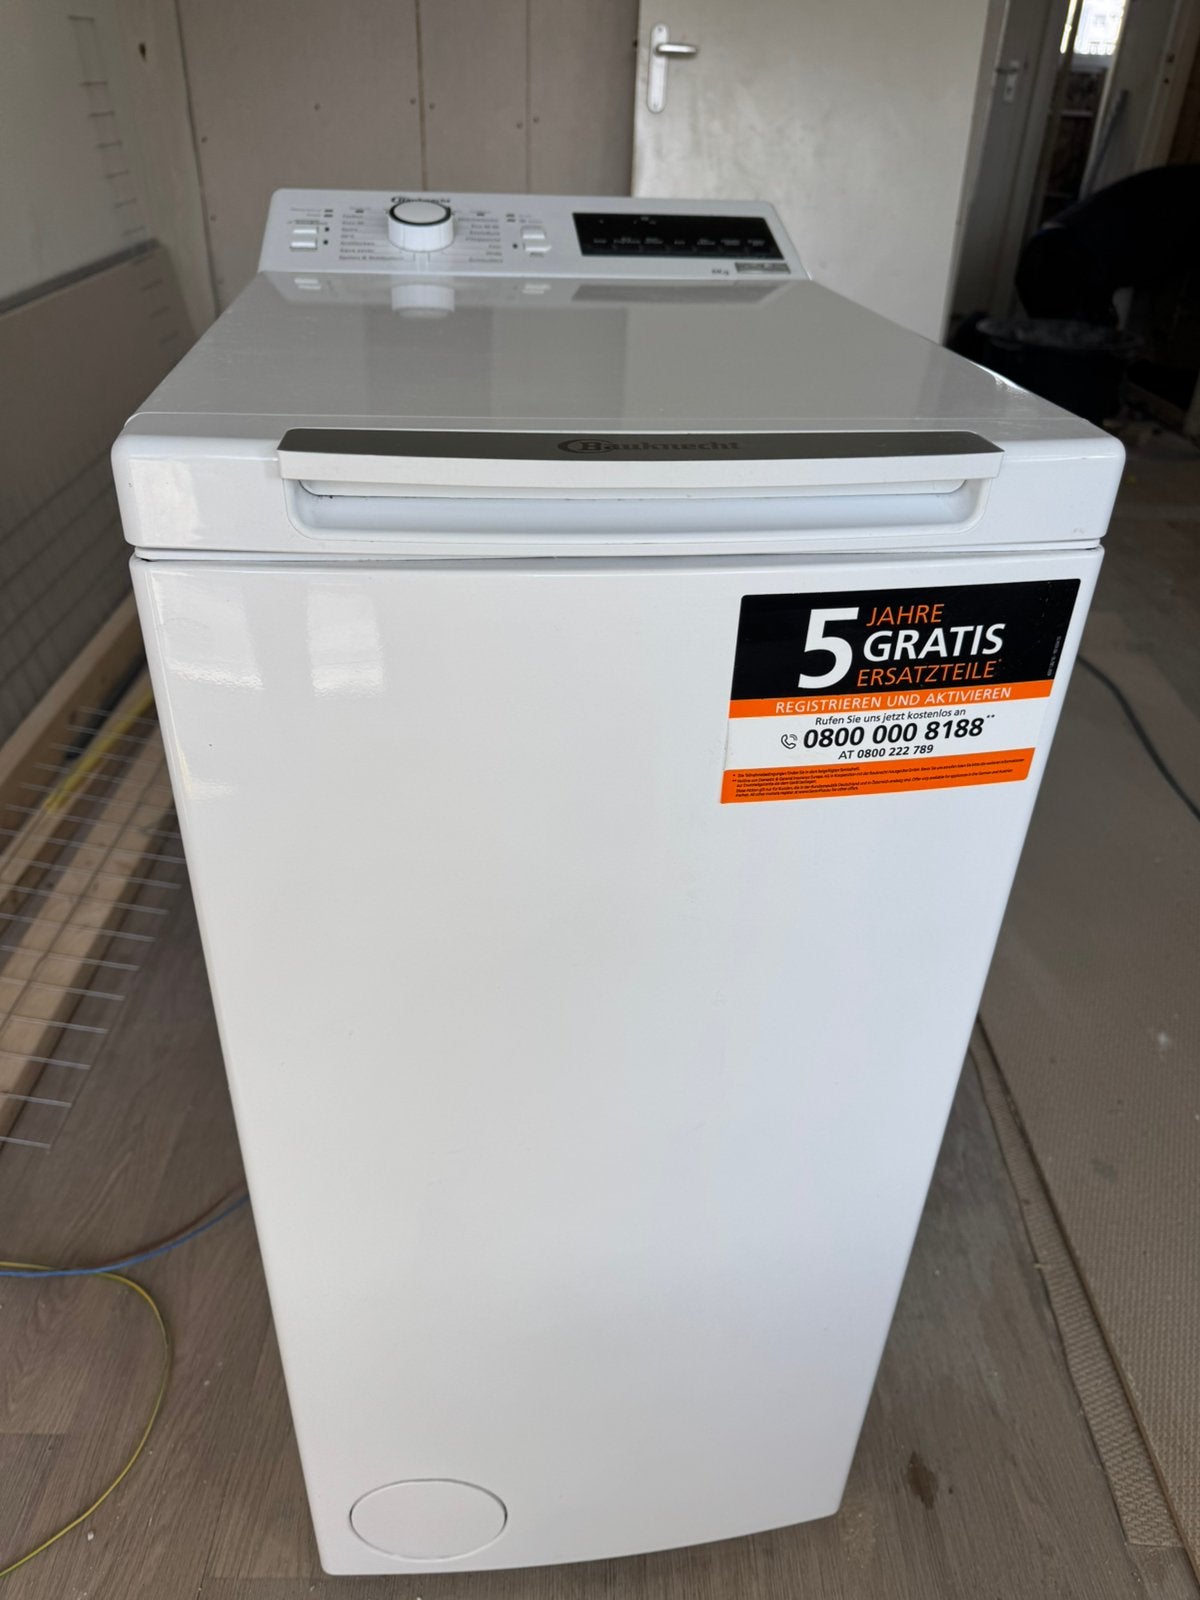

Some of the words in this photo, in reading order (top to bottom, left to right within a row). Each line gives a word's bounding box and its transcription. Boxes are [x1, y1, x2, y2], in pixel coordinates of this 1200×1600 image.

[558, 438, 740, 454] Bauknecht
[866, 603, 945, 627] JAHRE
[797, 606, 860, 689] 5
[863, 623, 1006, 662] GRATIS
[775, 697, 882, 714] REGISTRIEREN
[886, 694, 920, 707] UND
[924, 687, 1012, 705] AKTIVIEREN
[815, 715, 845, 726] Rufen
[846, 714, 862, 724] Sie
[863, 715, 881, 723] uns
[881, 712, 906, 725] jetzt
[906, 708, 952, 720] kostenlos
[953, 709, 966, 717] an
[803, 726, 865, 749] 0800
[872, 723, 918, 745] 000
[838, 750, 854, 760] AT
[856, 747, 886, 759] 0800
[888, 745, 910, 757] 222
[912, 743, 935, 755] 789
